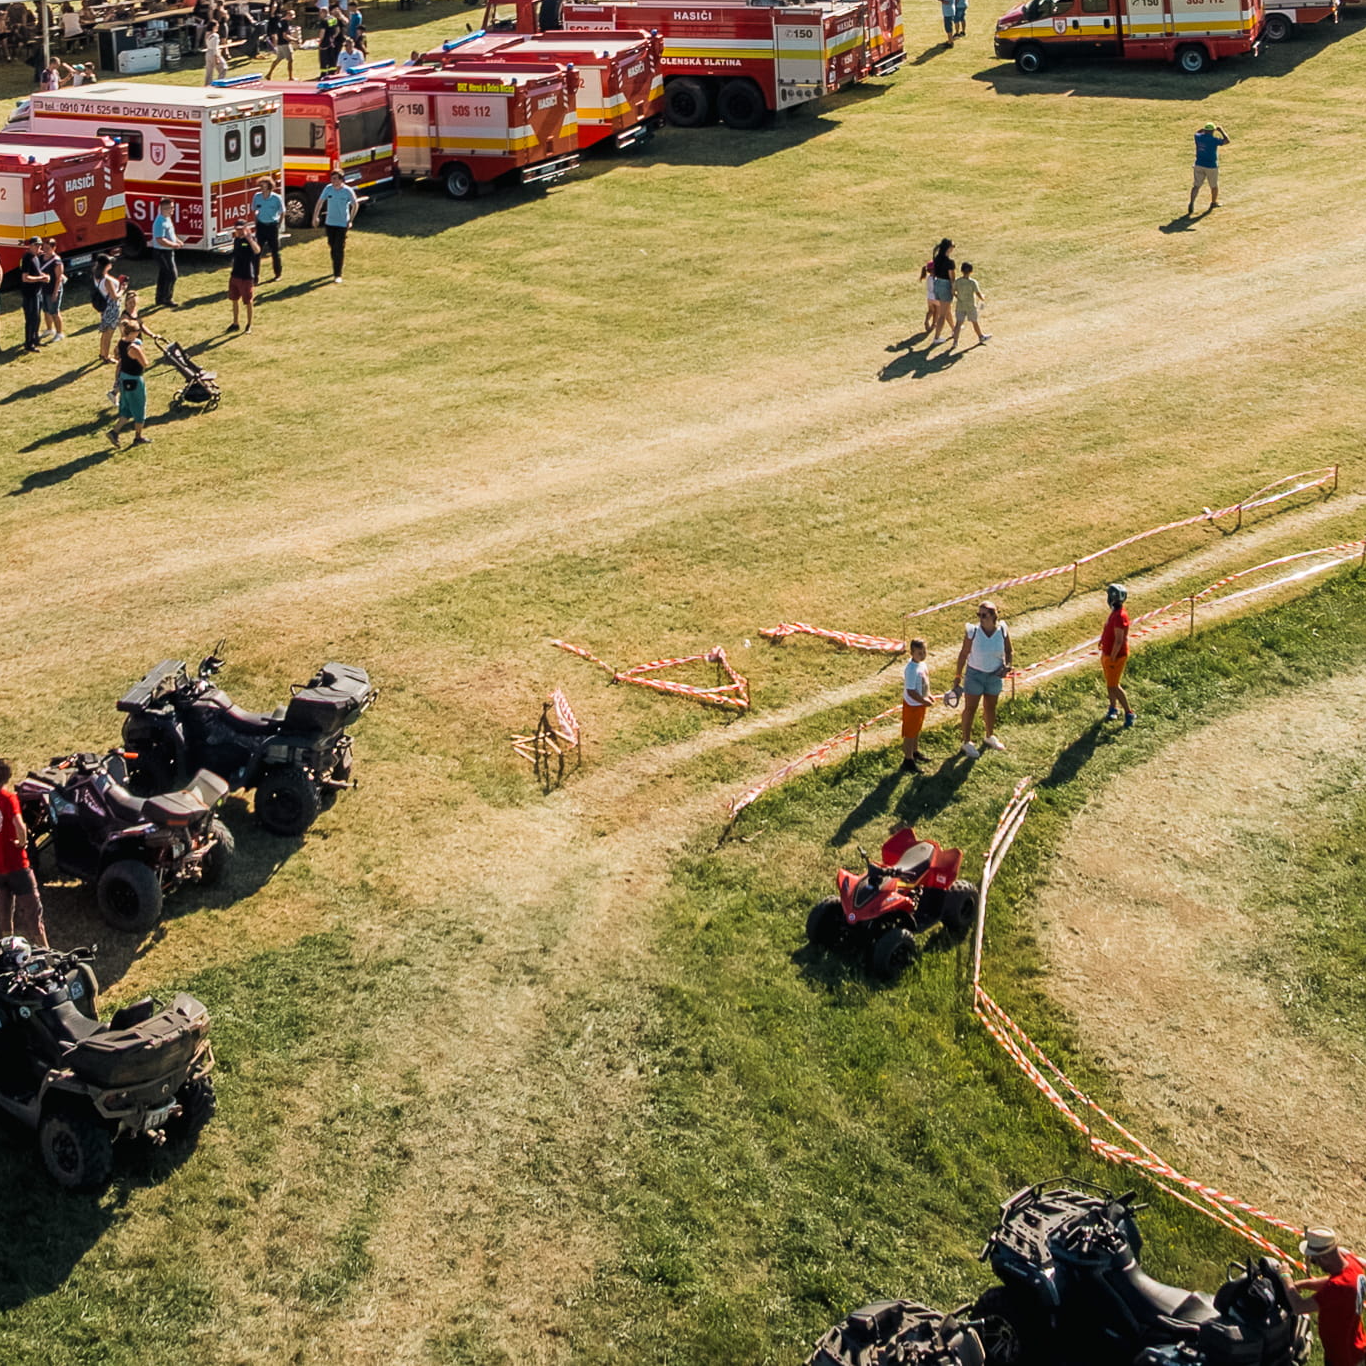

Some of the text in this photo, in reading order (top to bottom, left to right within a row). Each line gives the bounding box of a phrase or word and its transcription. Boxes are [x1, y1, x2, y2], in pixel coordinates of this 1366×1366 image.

[674, 10, 712, 21] HASIČI
[794, 29, 813, 39] 150
[660, 56, 742, 66] OLENSKÁ SLATINA
[60, 104, 79, 113] 0910
[80, 105, 94, 114] 741
[96, 105, 112, 115] 525
[122, 107, 149, 116] DHZM
[151, 108, 189, 120] ZVOLEN
[406, 104, 424, 115] 150
[452, 105, 491, 117] SOS 112
[65, 173, 95, 193] HASIČI
[188, 203, 203, 214] 150
[224, 203, 251, 220] HASI
[188, 219, 203, 229] 112
